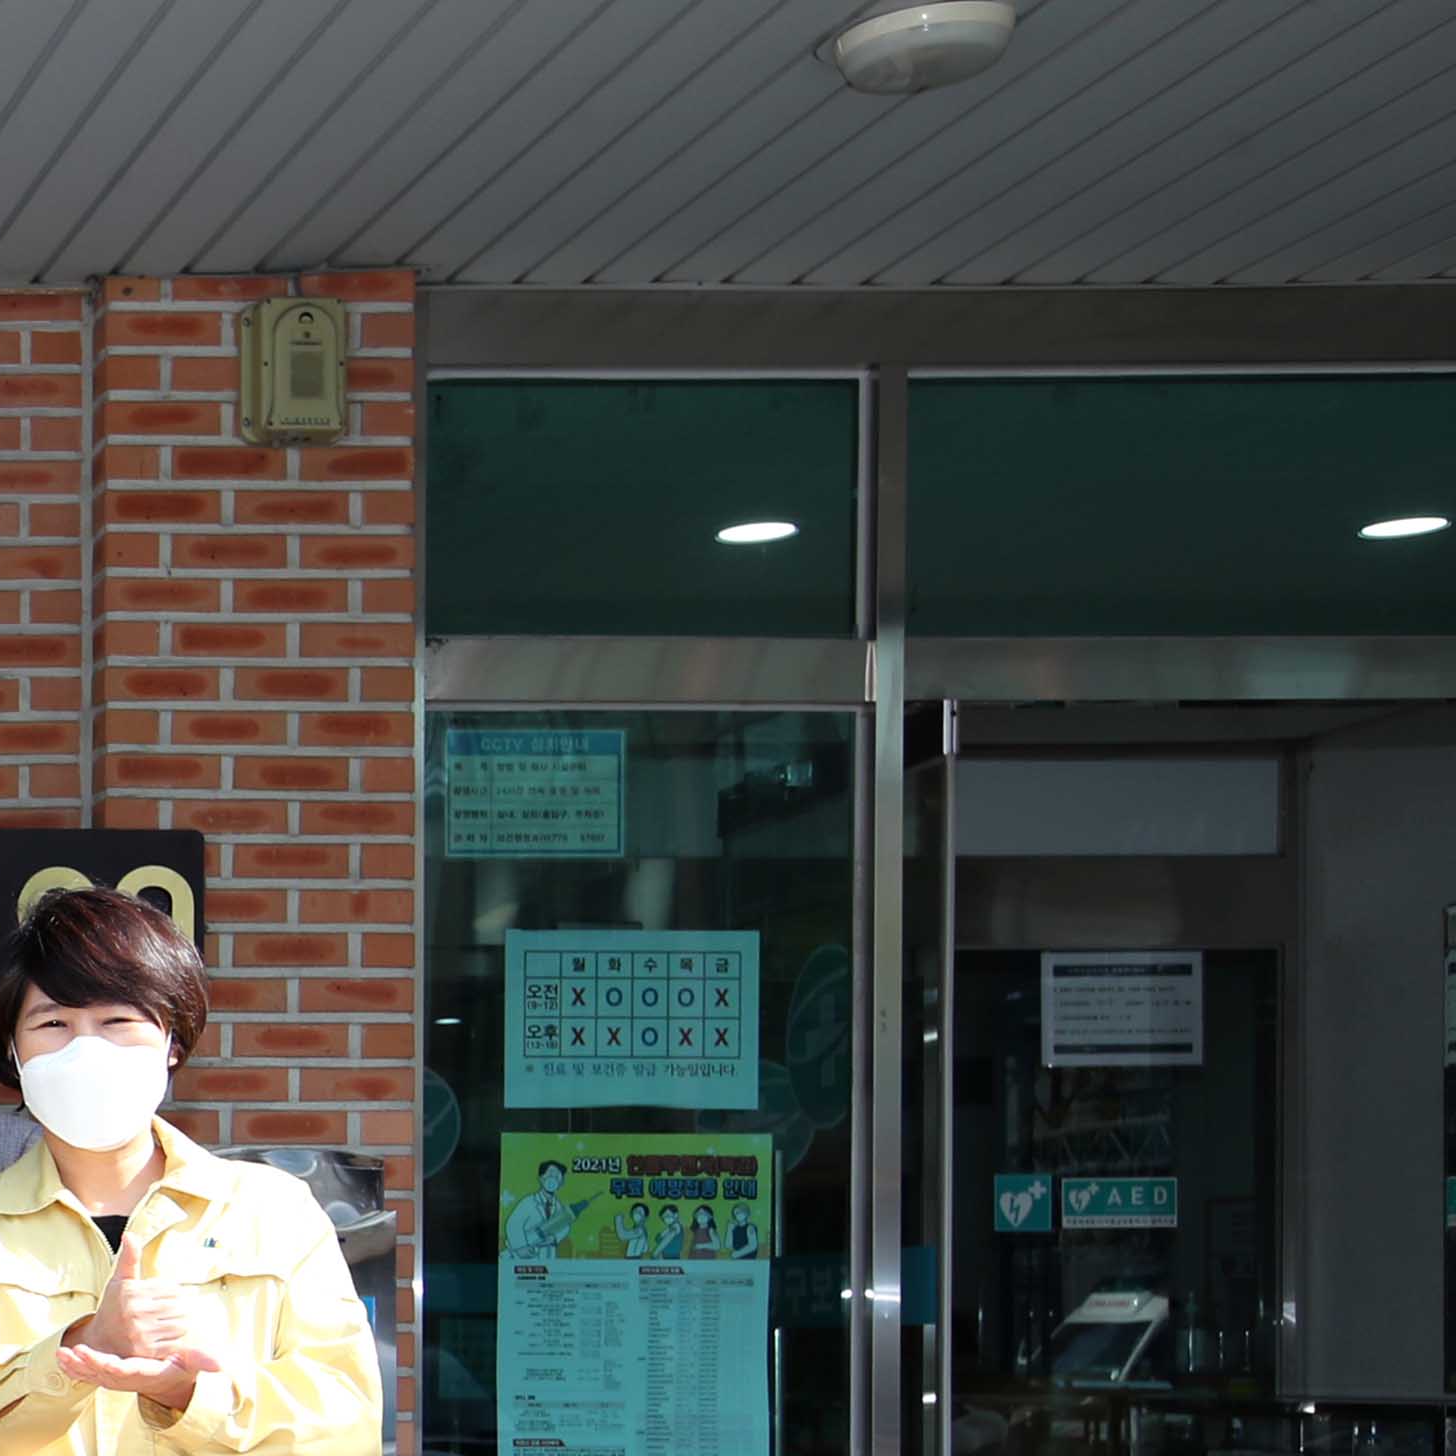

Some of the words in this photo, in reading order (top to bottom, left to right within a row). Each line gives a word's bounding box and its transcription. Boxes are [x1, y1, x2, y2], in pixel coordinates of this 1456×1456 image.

[573, 957, 585, 972] 월
[608, 957, 621, 972] 화
[644, 958, 657, 972] 수
[715, 958, 729, 973] 금
[527, 984, 558, 1000] 오전
[527, 1024, 558, 1041] 오후
[572, 1156, 622, 1174] 2021년
